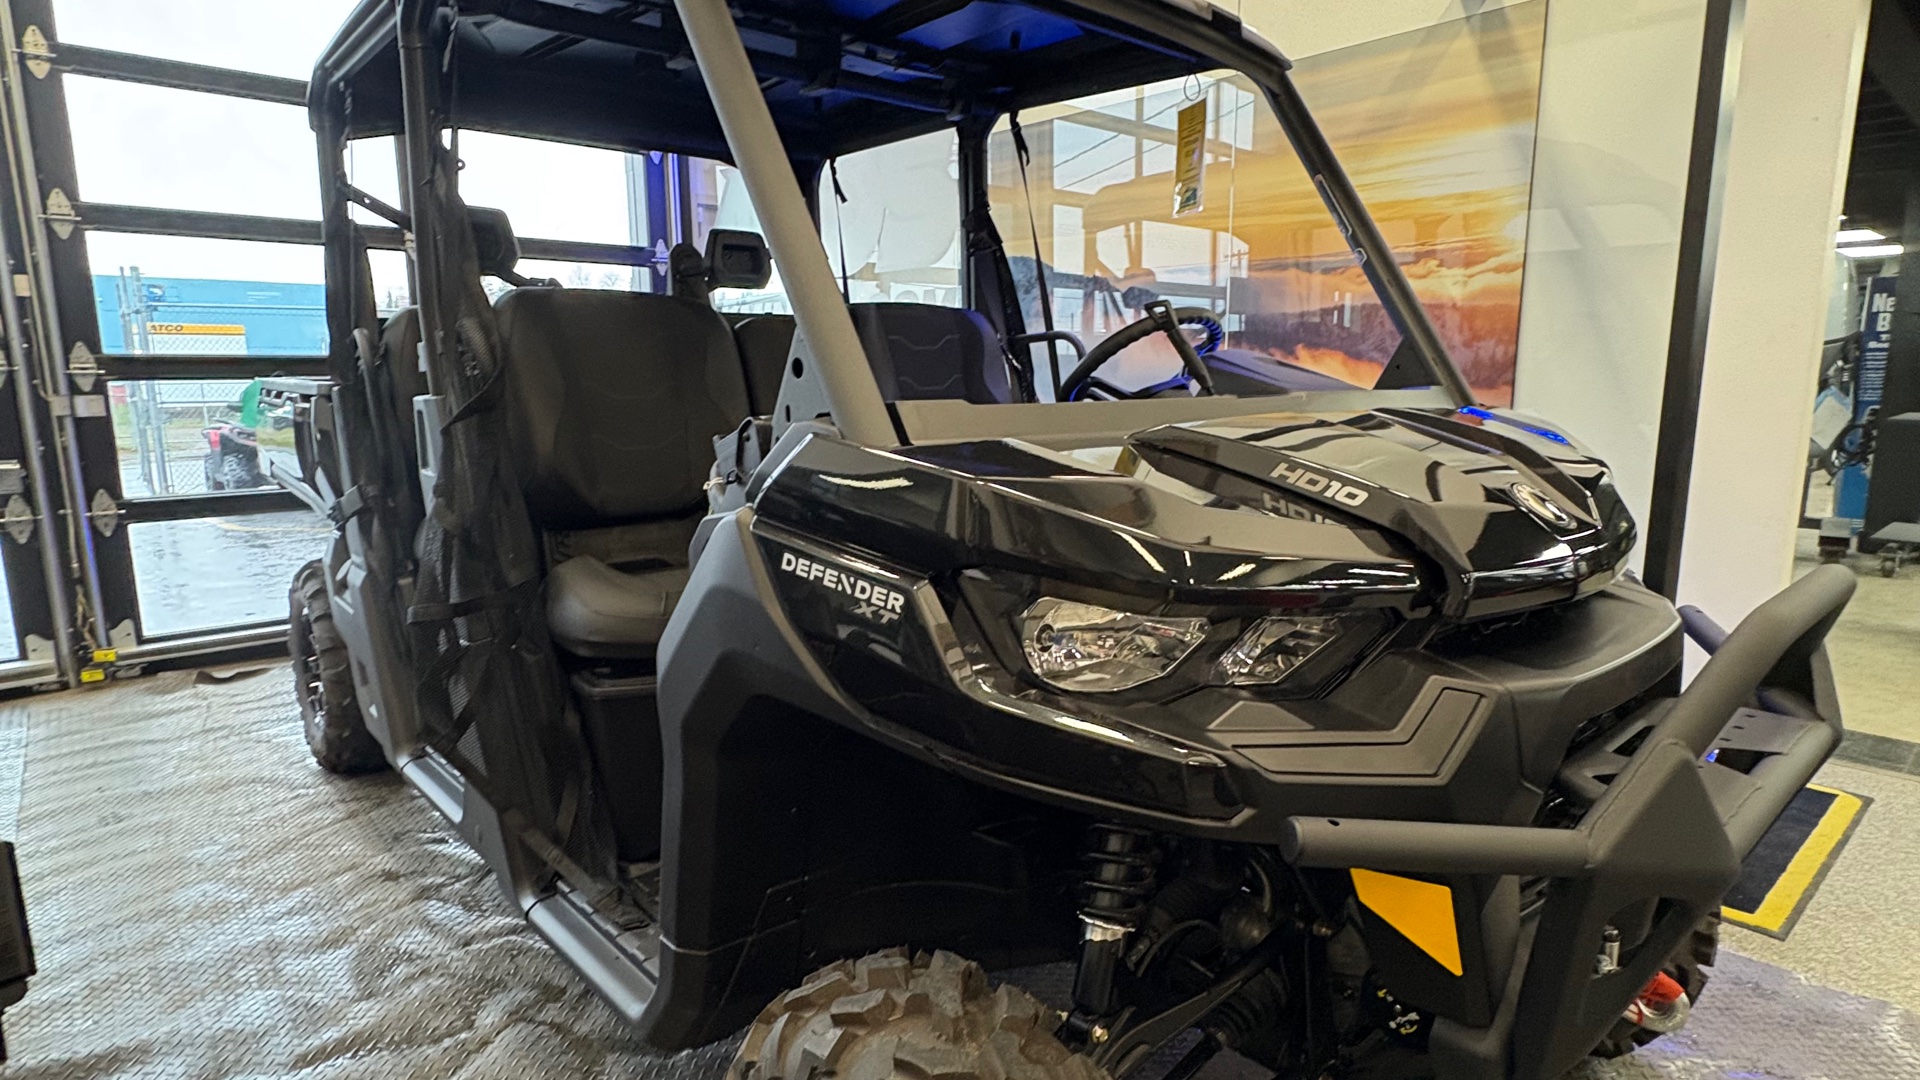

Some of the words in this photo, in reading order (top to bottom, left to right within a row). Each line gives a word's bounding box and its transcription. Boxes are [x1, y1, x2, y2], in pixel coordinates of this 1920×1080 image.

[150, 324, 184, 332] ATCO
[1269, 462, 1369, 507] HD10
[781, 552, 905, 613] DEFENDER
[852, 601, 900, 624] XT
